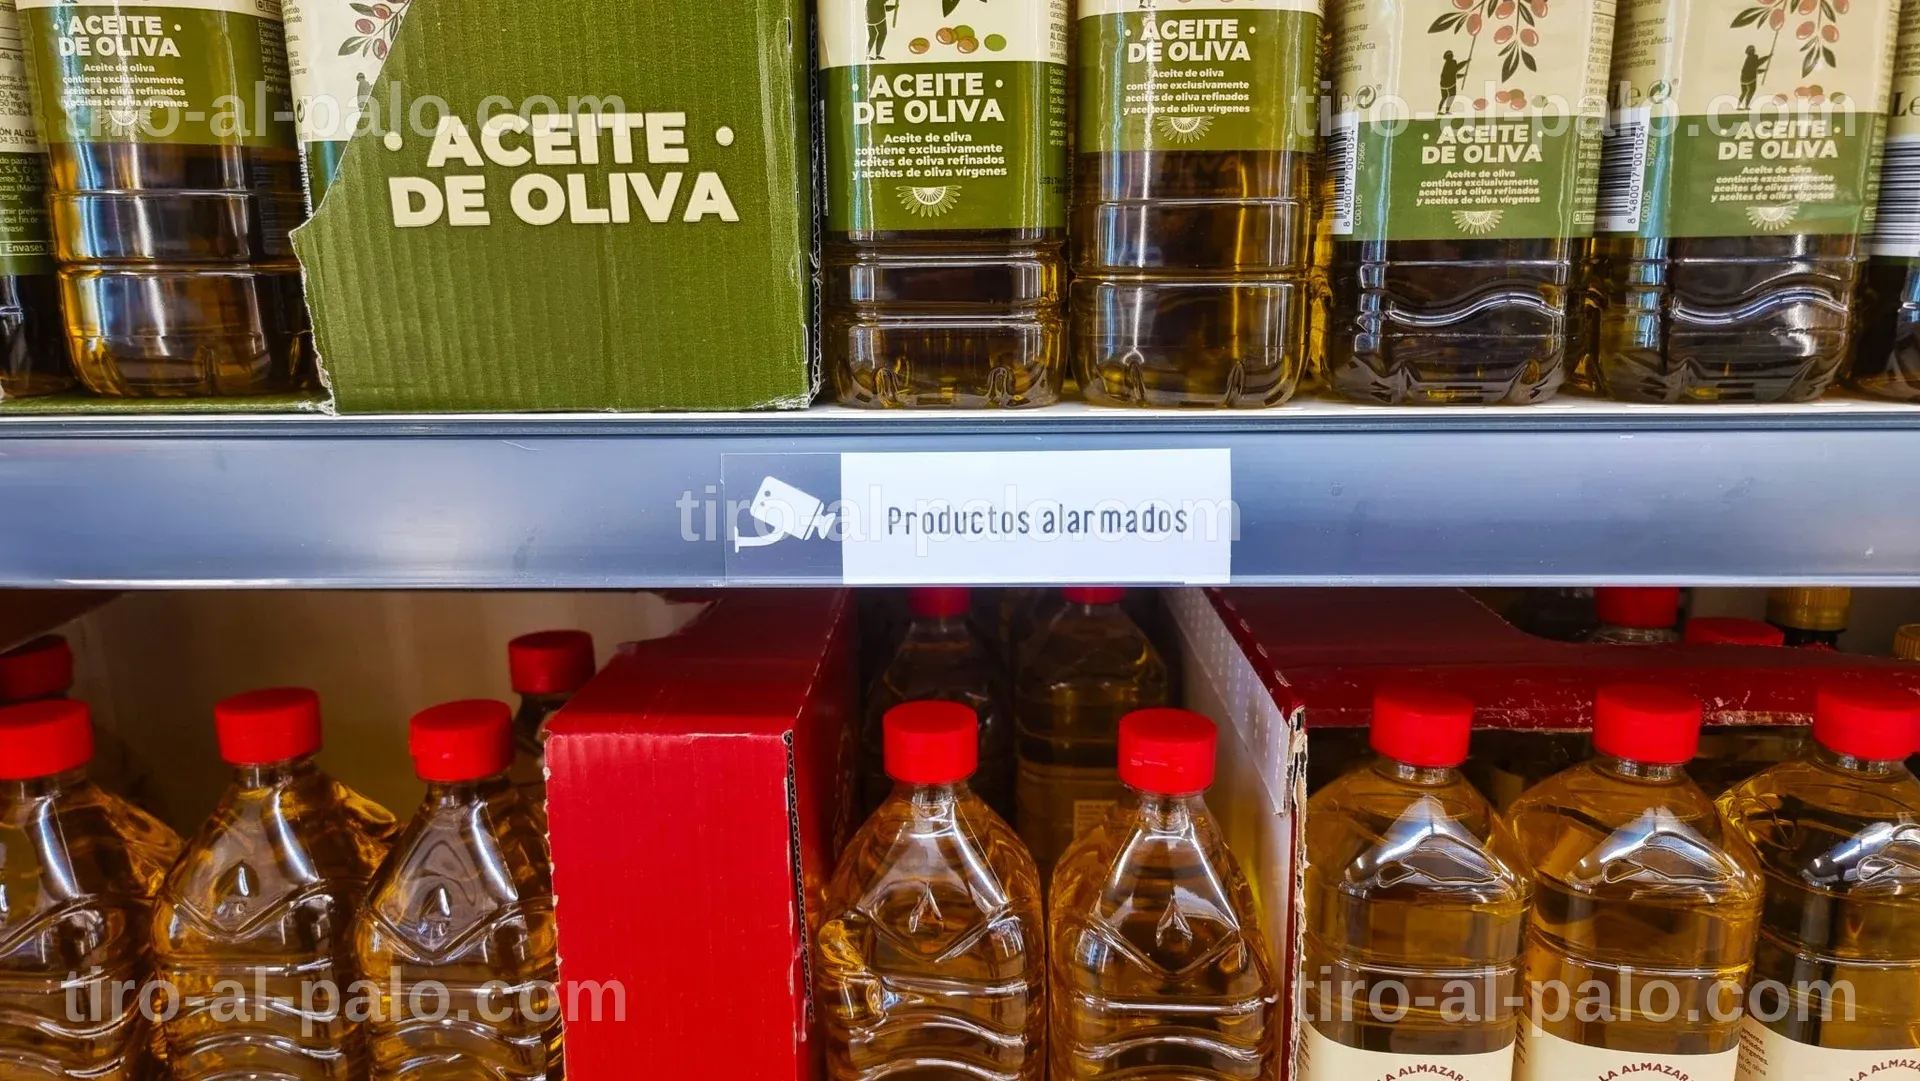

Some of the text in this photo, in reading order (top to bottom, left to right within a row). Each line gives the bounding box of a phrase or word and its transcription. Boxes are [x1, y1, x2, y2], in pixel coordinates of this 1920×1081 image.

[68, 16, 163, 35] ACEITE
[1140, 19, 1238, 41] ACEITE
[58, 37, 181, 57] DE OLIVA
[1128, 40, 1251, 63] DE OLIVA
[84, 64, 155, 72] Aceite de oliva
[1152, 68, 1224, 78] Aceite de oliva
[63, 75, 184, 84] contiene exclusivamente
[870, 73, 984, 98] ACEITE
[64, 86, 186, 96] aceites de oliva refinados
[1126, 81, 1249, 91] contiene exclusivamente
[71, 98, 101, 107] aceites
[104, 98, 115, 107] de
[117, 98, 141, 107] oliva
[1125, 92, 1249, 102] aceites de oliva refinados
[853, 99, 1005, 125] DE OLIVA
[1131, 105, 1165, 113] aceites
[1167, 105, 1179, 113] de
[1181, 105, 1205, 113] oliva
[1207, 104, 1250, 114] vírgenes
[1437, 125, 1529, 144] ACEITE
[1734, 120, 1826, 140] ACEITE
[426, 112, 689, 167] ACEITE
[884, 132, 972, 144] Aceite de oliva
[855, 144, 1002, 155] contiene exclusivamente
[1346, 130, 1355, 170] 001054
[1633, 125, 1645, 166] 001054
[1718, 140, 1838, 160] DE OLIVA
[1422, 144, 1543, 164] DE OLIVA
[854, 155, 1004, 167] aceites de oliva refinados
[862, 168, 903, 178] aceites
[906, 168, 920, 177] de
[924, 167, 952, 177] oliva
[956, 167, 1007, 178] vírgenes
[1446, 169, 1515, 179] Aceite de oliva
[1741, 165, 1812, 174] Aceite de oliva
[1421, 178, 1539, 188] contiene exclusivamente
[1716, 174, 1834, 184] contiene exclusivamente
[1419, 186, 1539, 196] aceites de oliva refinados
[1629, 172, 1640, 213] 480017
[1714, 183, 1836, 192] aceites de oliva refinados
[388, 171, 740, 227] DE OLIVA
[1344, 176, 1353, 215] 480017
[1425, 197, 1458, 205] aceites
[1461, 196, 1472, 204] de
[1475, 196, 1498, 204] oliva
[1500, 195, 1540, 205] vírgenes
[1719, 193, 1754, 201] aceites
[1755, 192, 1767, 200] de
[1769, 192, 1792, 200] oliva
[6, 243, 44, 253] Envases
[888, 503, 1188, 535] Productos alarmados
[1399, 1064, 1469, 1081] ALMAZAR
[1621, 1062, 1694, 1081] ALMAZAR
